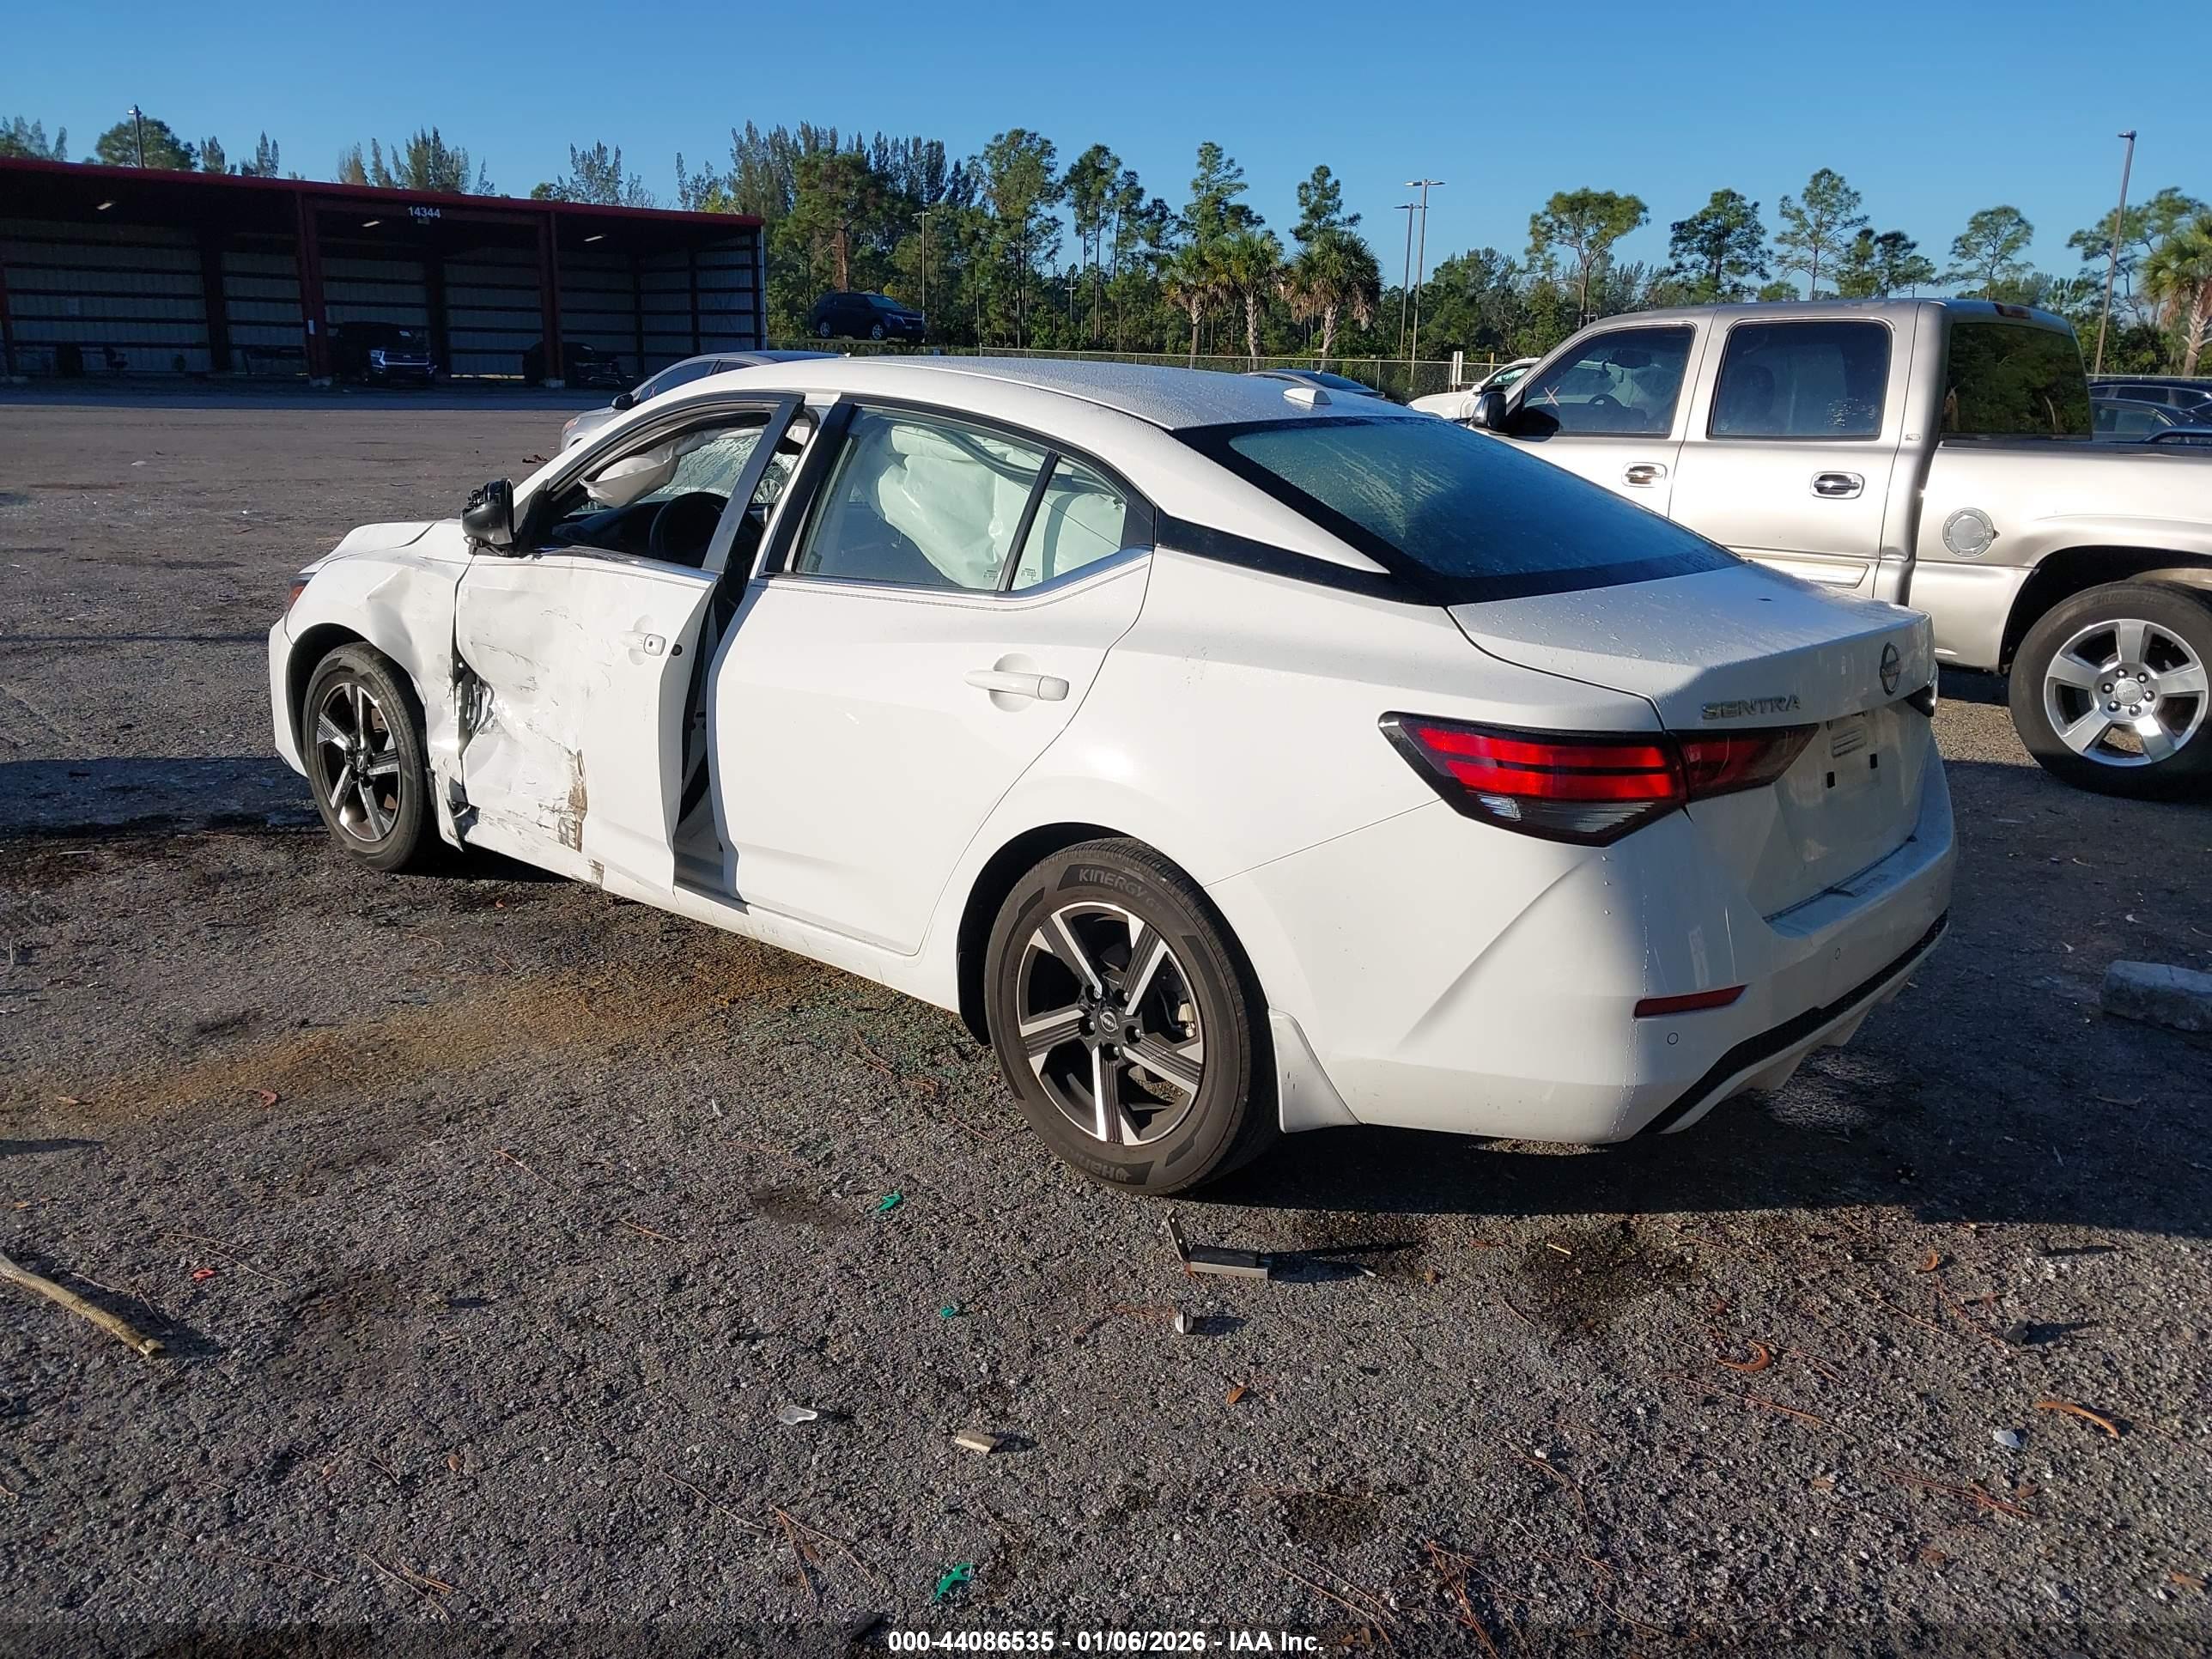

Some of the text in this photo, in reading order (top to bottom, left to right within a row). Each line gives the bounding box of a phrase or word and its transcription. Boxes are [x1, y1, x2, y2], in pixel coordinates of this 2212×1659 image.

[408, 207, 441, 218] 14344
[1703, 695, 1800, 720] SENTRA
[1079, 868, 1148, 898] KINERGY
